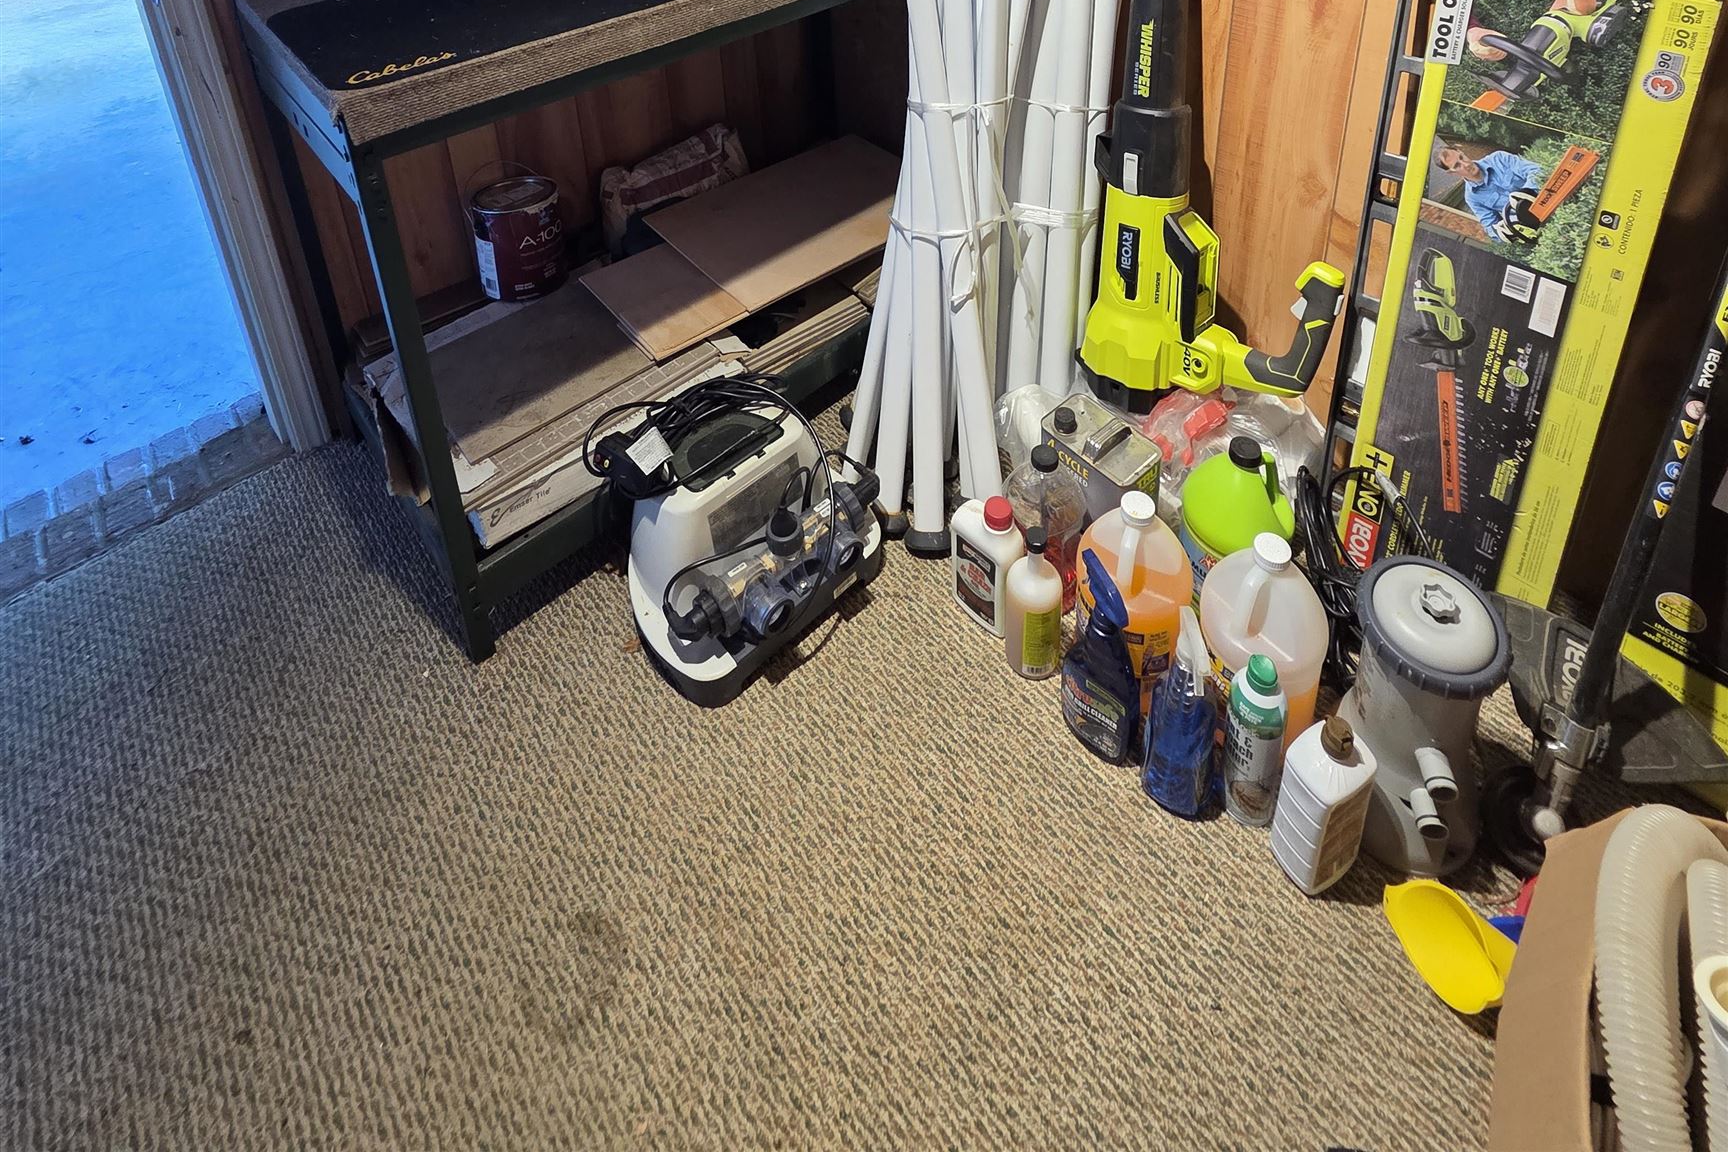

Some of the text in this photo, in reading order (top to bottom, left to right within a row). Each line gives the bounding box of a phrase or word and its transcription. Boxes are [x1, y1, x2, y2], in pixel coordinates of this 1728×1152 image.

[1680, 5, 1698, 25] 90
[1432, 14, 1455, 58] TOOL
[1673, 29, 1690, 49] 90
[345, 52, 457, 85] Cabela's
[1138, 18, 1154, 98] WHISPER
[1658, 53, 1672, 69] 90
[1650, 77, 1675, 95] 3
[1631, 189, 1643, 208] PIEZA
[1120, 231, 1133, 270] RYOBI
[1488, 327, 1500, 350] WORKS
[1496, 328, 1509, 356] BATTERY
[1485, 350, 1495, 366] TOOL
[1697, 348, 1722, 388] RYOBI
[1488, 374, 1498, 389] ANY
[1477, 386, 1487, 400] ANY
[1484, 388, 1495, 404] WITH
[1058, 450, 1089, 480] CYCLE
[1400, 469, 1412, 498] RIMMER
[509, 487, 551, 514] Emser Tile
[1642, 631, 1661, 644] AND
